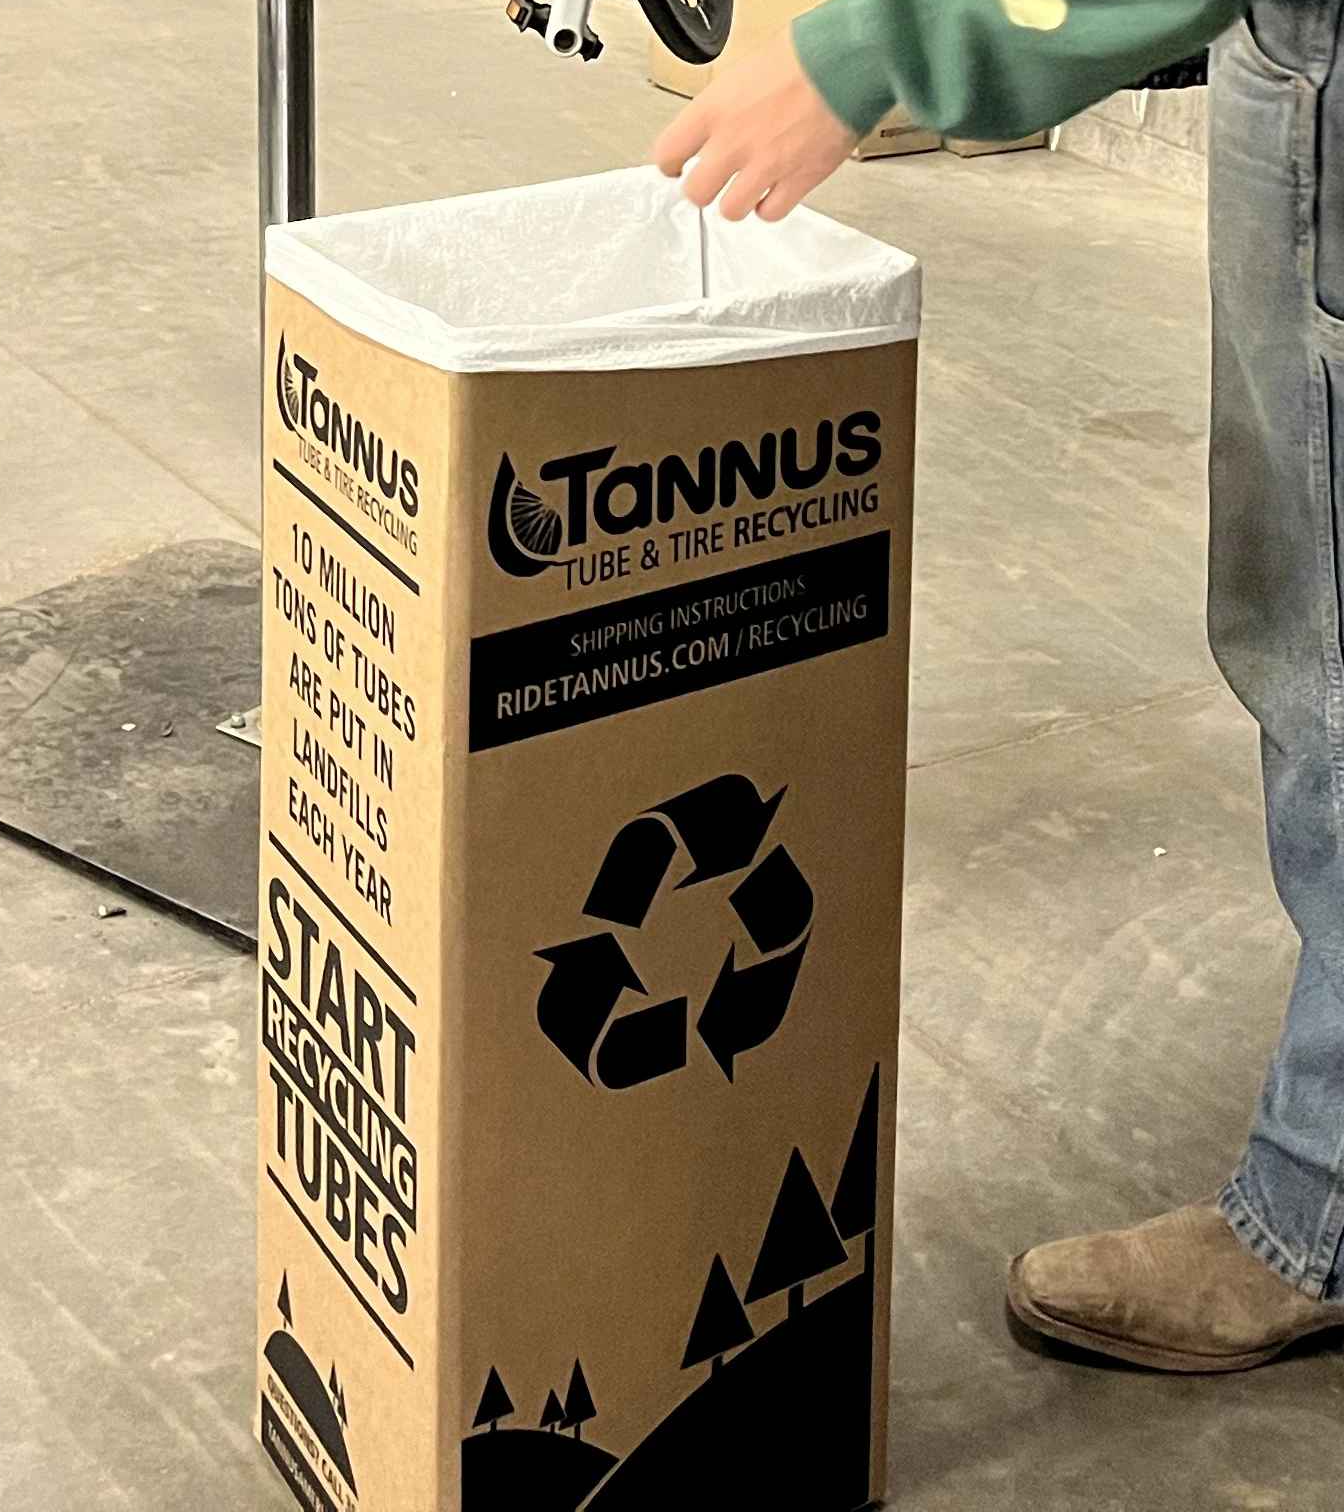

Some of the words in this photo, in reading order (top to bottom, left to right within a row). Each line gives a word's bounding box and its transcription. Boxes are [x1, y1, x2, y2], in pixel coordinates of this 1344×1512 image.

[299, 437, 322, 475] TUBE
[324, 457, 332, 484] &
[334, 463, 355, 503] TIRE
[357, 484, 417, 557] RECYCLING
[563, 550, 632, 591] TUBE
[640, 541, 661, 569] &
[668, 526, 726, 563] TIRE
[732, 483, 879, 549] RECYCLING
[273, 567, 317, 649] TONS
[324, 612, 346, 666] OF
[351, 636, 416, 743] TUBES
[292, 522, 313, 578] 10
[319, 544, 395, 655] MILLION
[569, 610, 664, 657] SHIPPING
[670, 574, 806, 630] INSTRUCTIONS
[289, 651, 323, 712] ARE
[329, 686, 364, 761] PUT
[373, 728, 393, 792] IN
[292, 717, 388, 854] LANDFILLS
[288, 775, 336, 861] EACH
[341, 821, 392, 928] YEAR
[267, 877, 416, 1125] START
[267, 995, 415, 1210] RECYCLING
[269, 1061, 408, 1316] TUBES
